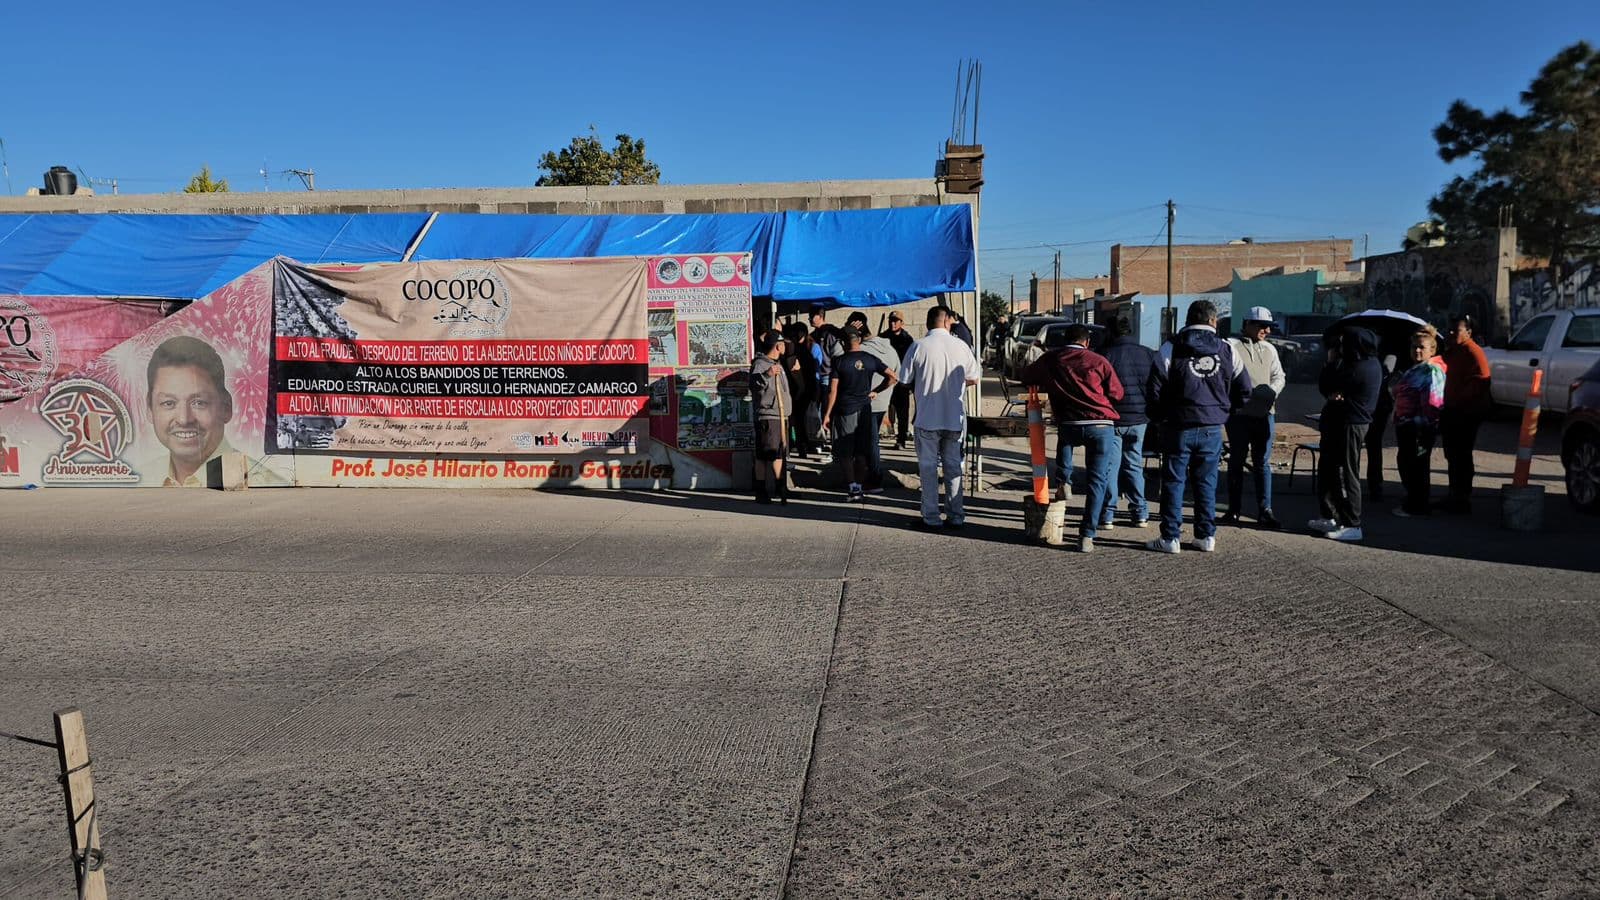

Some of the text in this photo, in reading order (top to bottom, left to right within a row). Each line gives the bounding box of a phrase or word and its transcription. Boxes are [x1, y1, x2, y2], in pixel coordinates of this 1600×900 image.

[402, 278, 495, 301] COCOPO
[288, 341, 308, 358] ALTO
[309, 342, 320, 358] AL
[321, 342, 354, 360] FRAUDE
[362, 344, 400, 361] DESPOJO
[402, 345, 417, 361] DEL
[420, 345, 458, 361] TERRENO
[462, 345, 474, 361] DE
[476, 345, 486, 361] LA
[487, 345, 525, 361] ALBERCA
[526, 345, 537, 361] DE
[539, 345, 556, 361] LOS
[558, 342, 583, 361] NIÑOS
[585, 344, 597, 361] DE
[599, 344, 637, 360] COCOPO.
[356, 366, 568, 379] ALTO A LOS BANDIDOS DE TERRENOS.
[288, 379, 637, 394] EDUARDO ESTRADA CURIEL Y URSULO HERNANDEZ CAMARGO
[289, 396, 638, 416] ALTO A LA INTIMIDACION POR PARTE DE FISCALIA A LOS PROYECTOS EDUCATIVOS
[46, 457, 130, 476] Aniversario
[331, 457, 675, 480] Prof. José Hilario Román González
